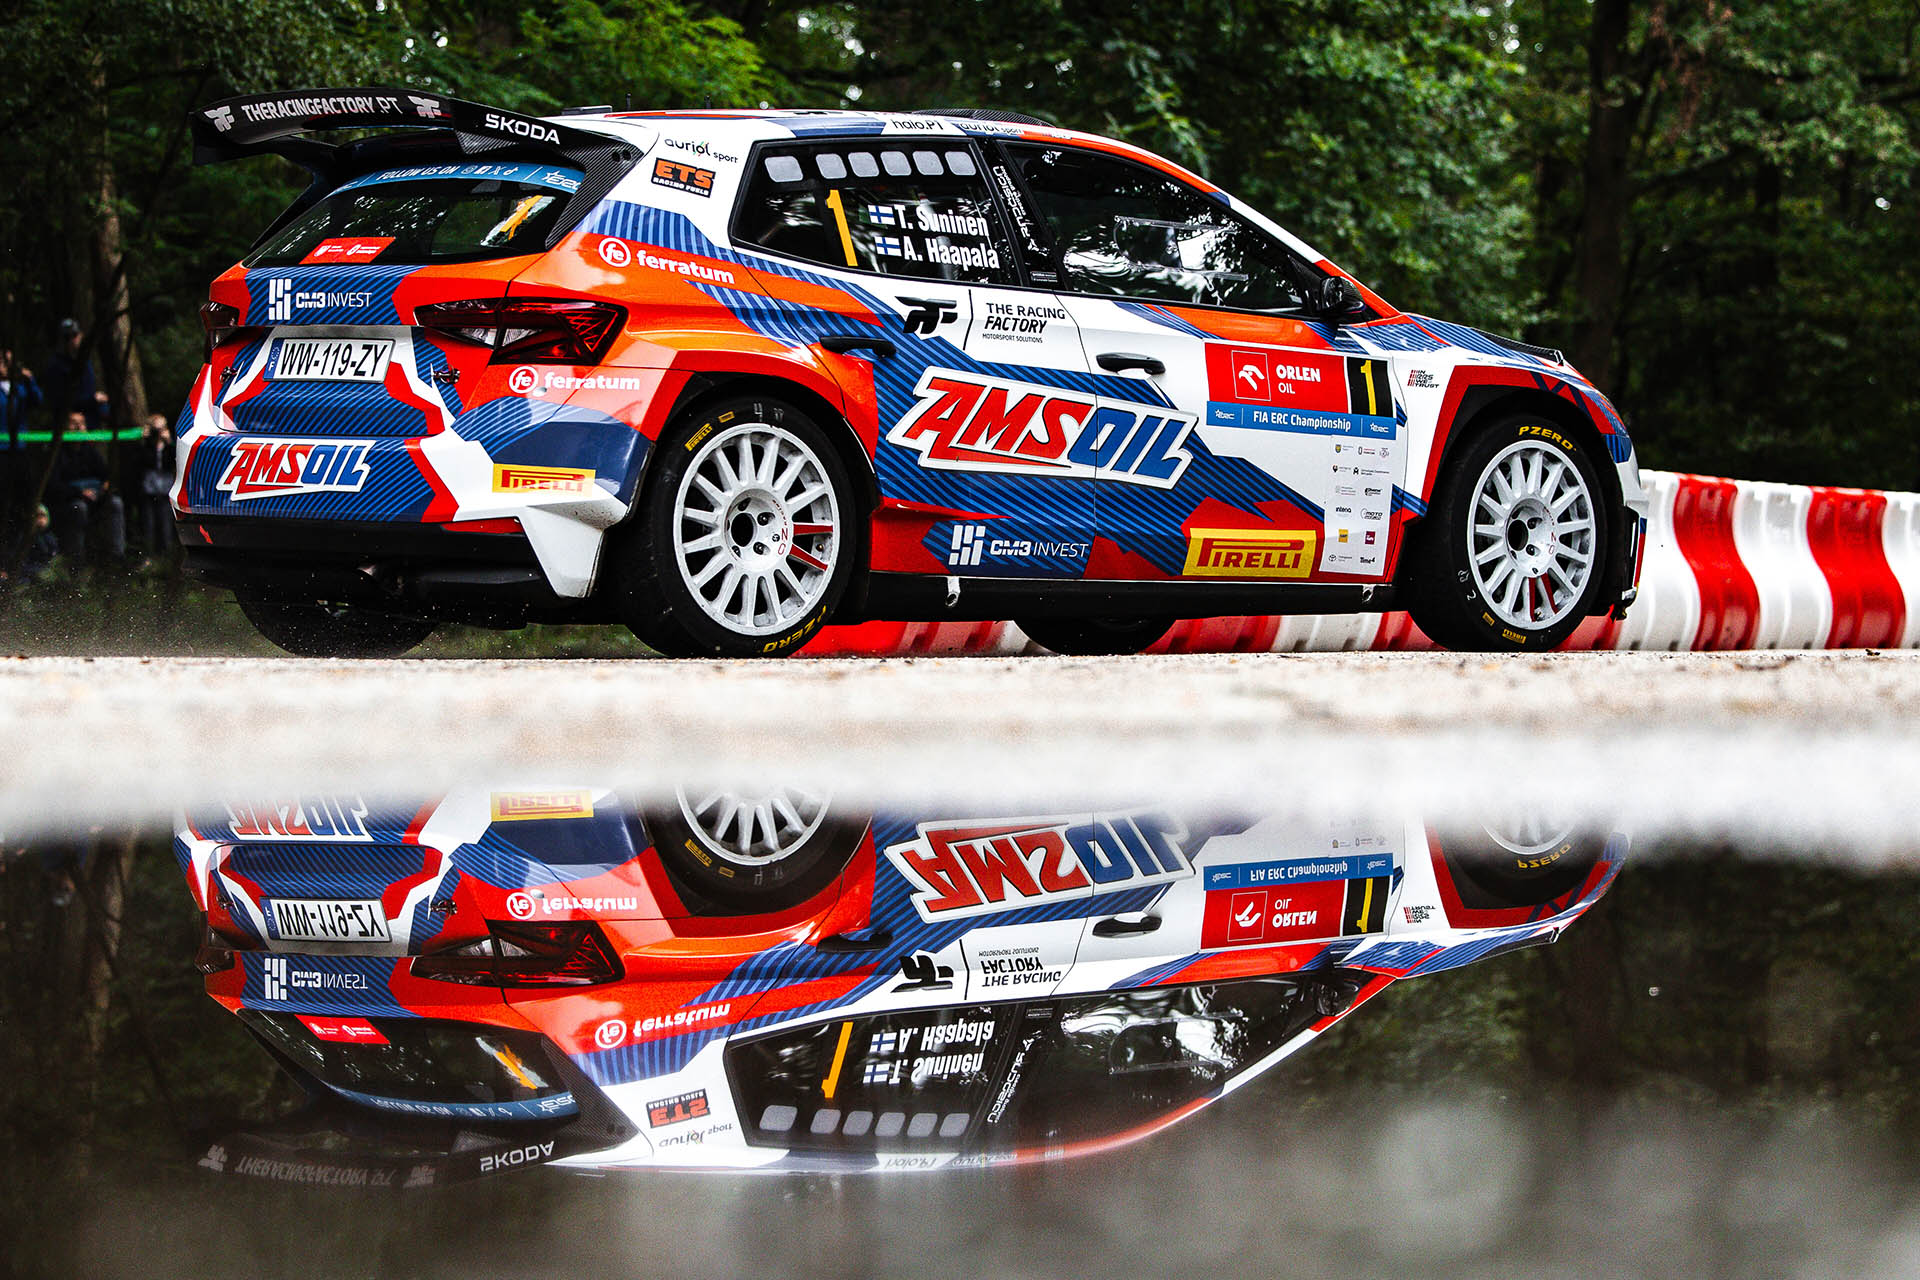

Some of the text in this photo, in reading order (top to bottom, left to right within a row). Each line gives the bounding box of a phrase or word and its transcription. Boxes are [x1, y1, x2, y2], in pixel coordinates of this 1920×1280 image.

[664, 138, 738, 164] auriol sport
[656, 159, 713, 189] ETS
[825, 189, 858, 267] 1
[894, 204, 989, 236] T. Suninen
[903, 236, 1000, 271] A. Haapala
[636, 250, 735, 284] ferratum
[296, 292, 372, 309] CM3 INVEST
[986, 303, 1066, 320] THE RACING
[984, 316, 1047, 334] FACTORY
[982, 333, 1043, 344] MOTORSPORT SOLUTIONS
[268, 361, 275, 372] F
[280, 343, 388, 377] WW-119-ZY
[544, 371, 640, 390] ferratum
[1275, 364, 1321, 383] ORLEN
[1278, 382, 1296, 395] OIL
[1360, 359, 1377, 415] 1
[902, 375, 1187, 480] AMSOIL
[1253, 410, 1268, 423] FIA
[1271, 412, 1287, 425] ERC
[1290, 414, 1351, 432] Championship
[223, 442, 367, 494] AMSOIL
[501, 469, 585, 492] PIRELLI
[990, 539, 1089, 558] CM3 INVEST
[1197, 538, 1304, 569] PIRELLI
